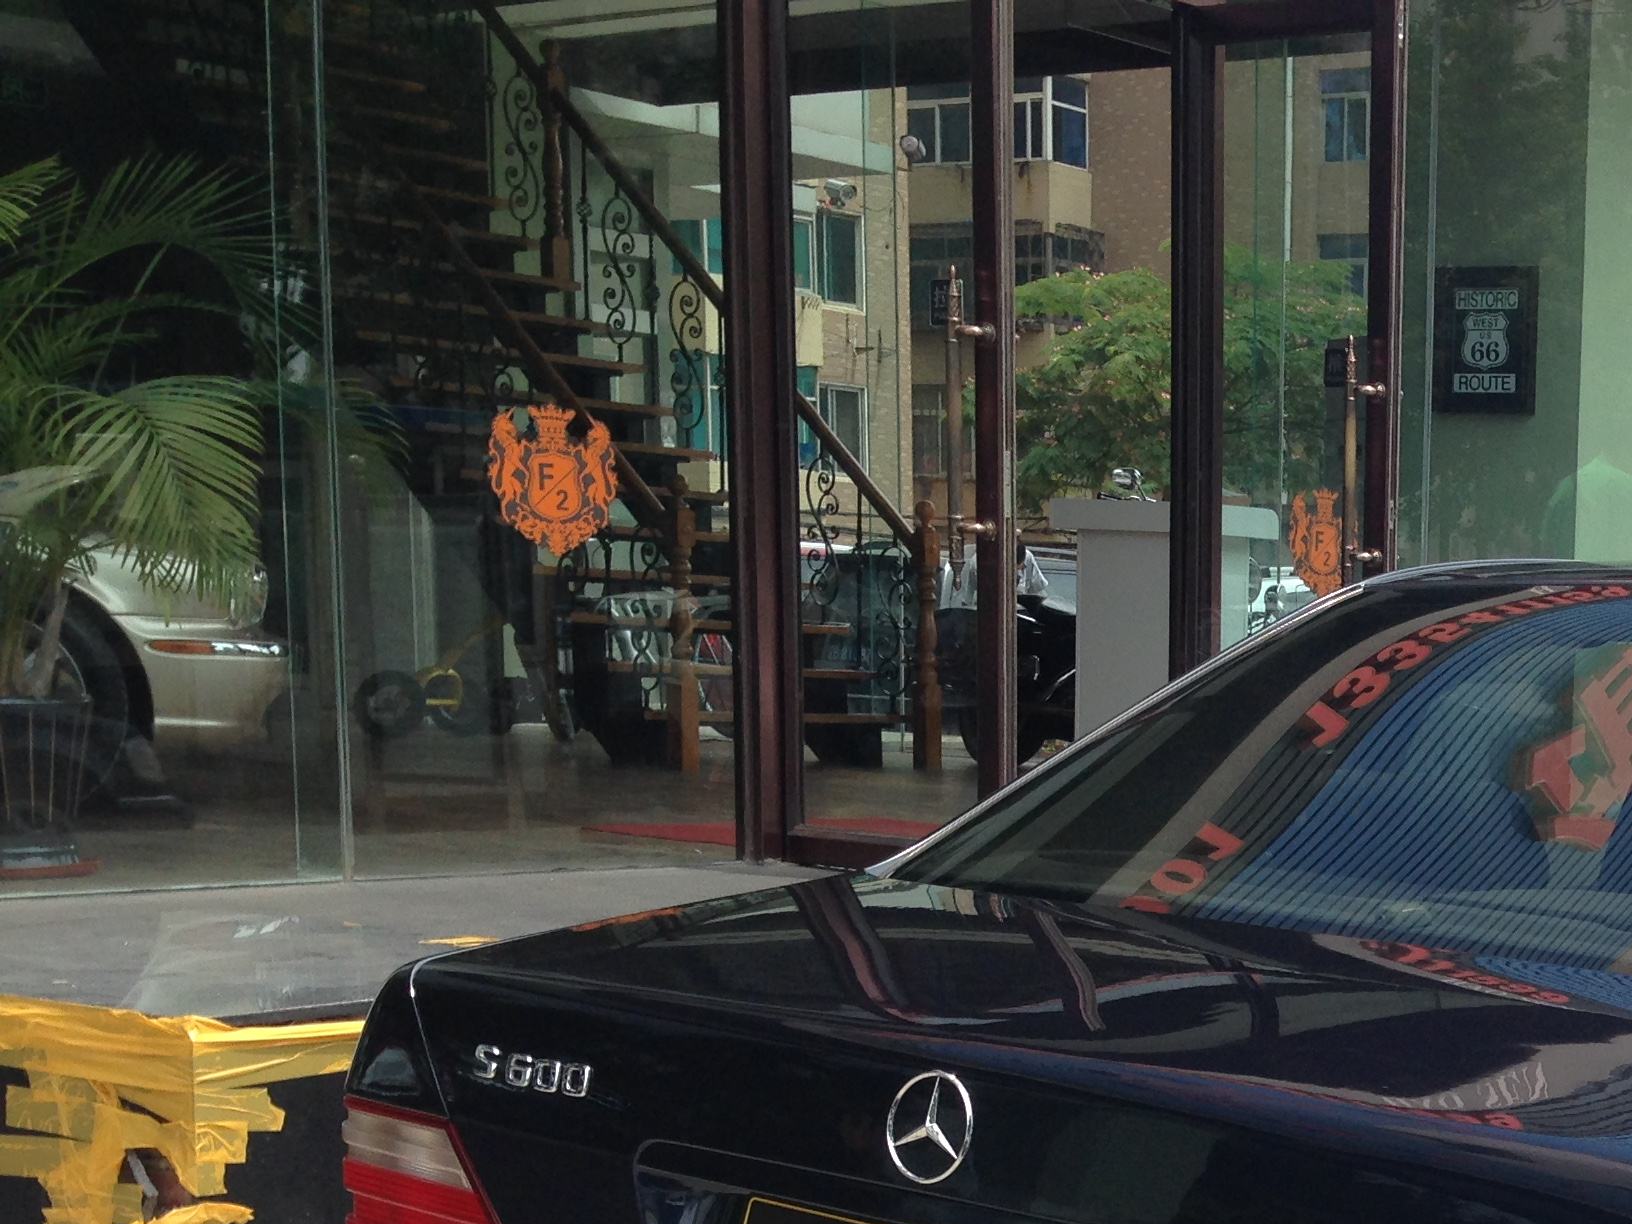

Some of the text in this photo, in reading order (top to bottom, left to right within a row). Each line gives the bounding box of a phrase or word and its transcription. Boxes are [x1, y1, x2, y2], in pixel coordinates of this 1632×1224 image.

[1457, 291, 1517, 308] HISTORIC
[1472, 318, 1499, 329] WEST
[1470, 341, 1500, 363] 66
[1458, 375, 1511, 391] ROUTE
